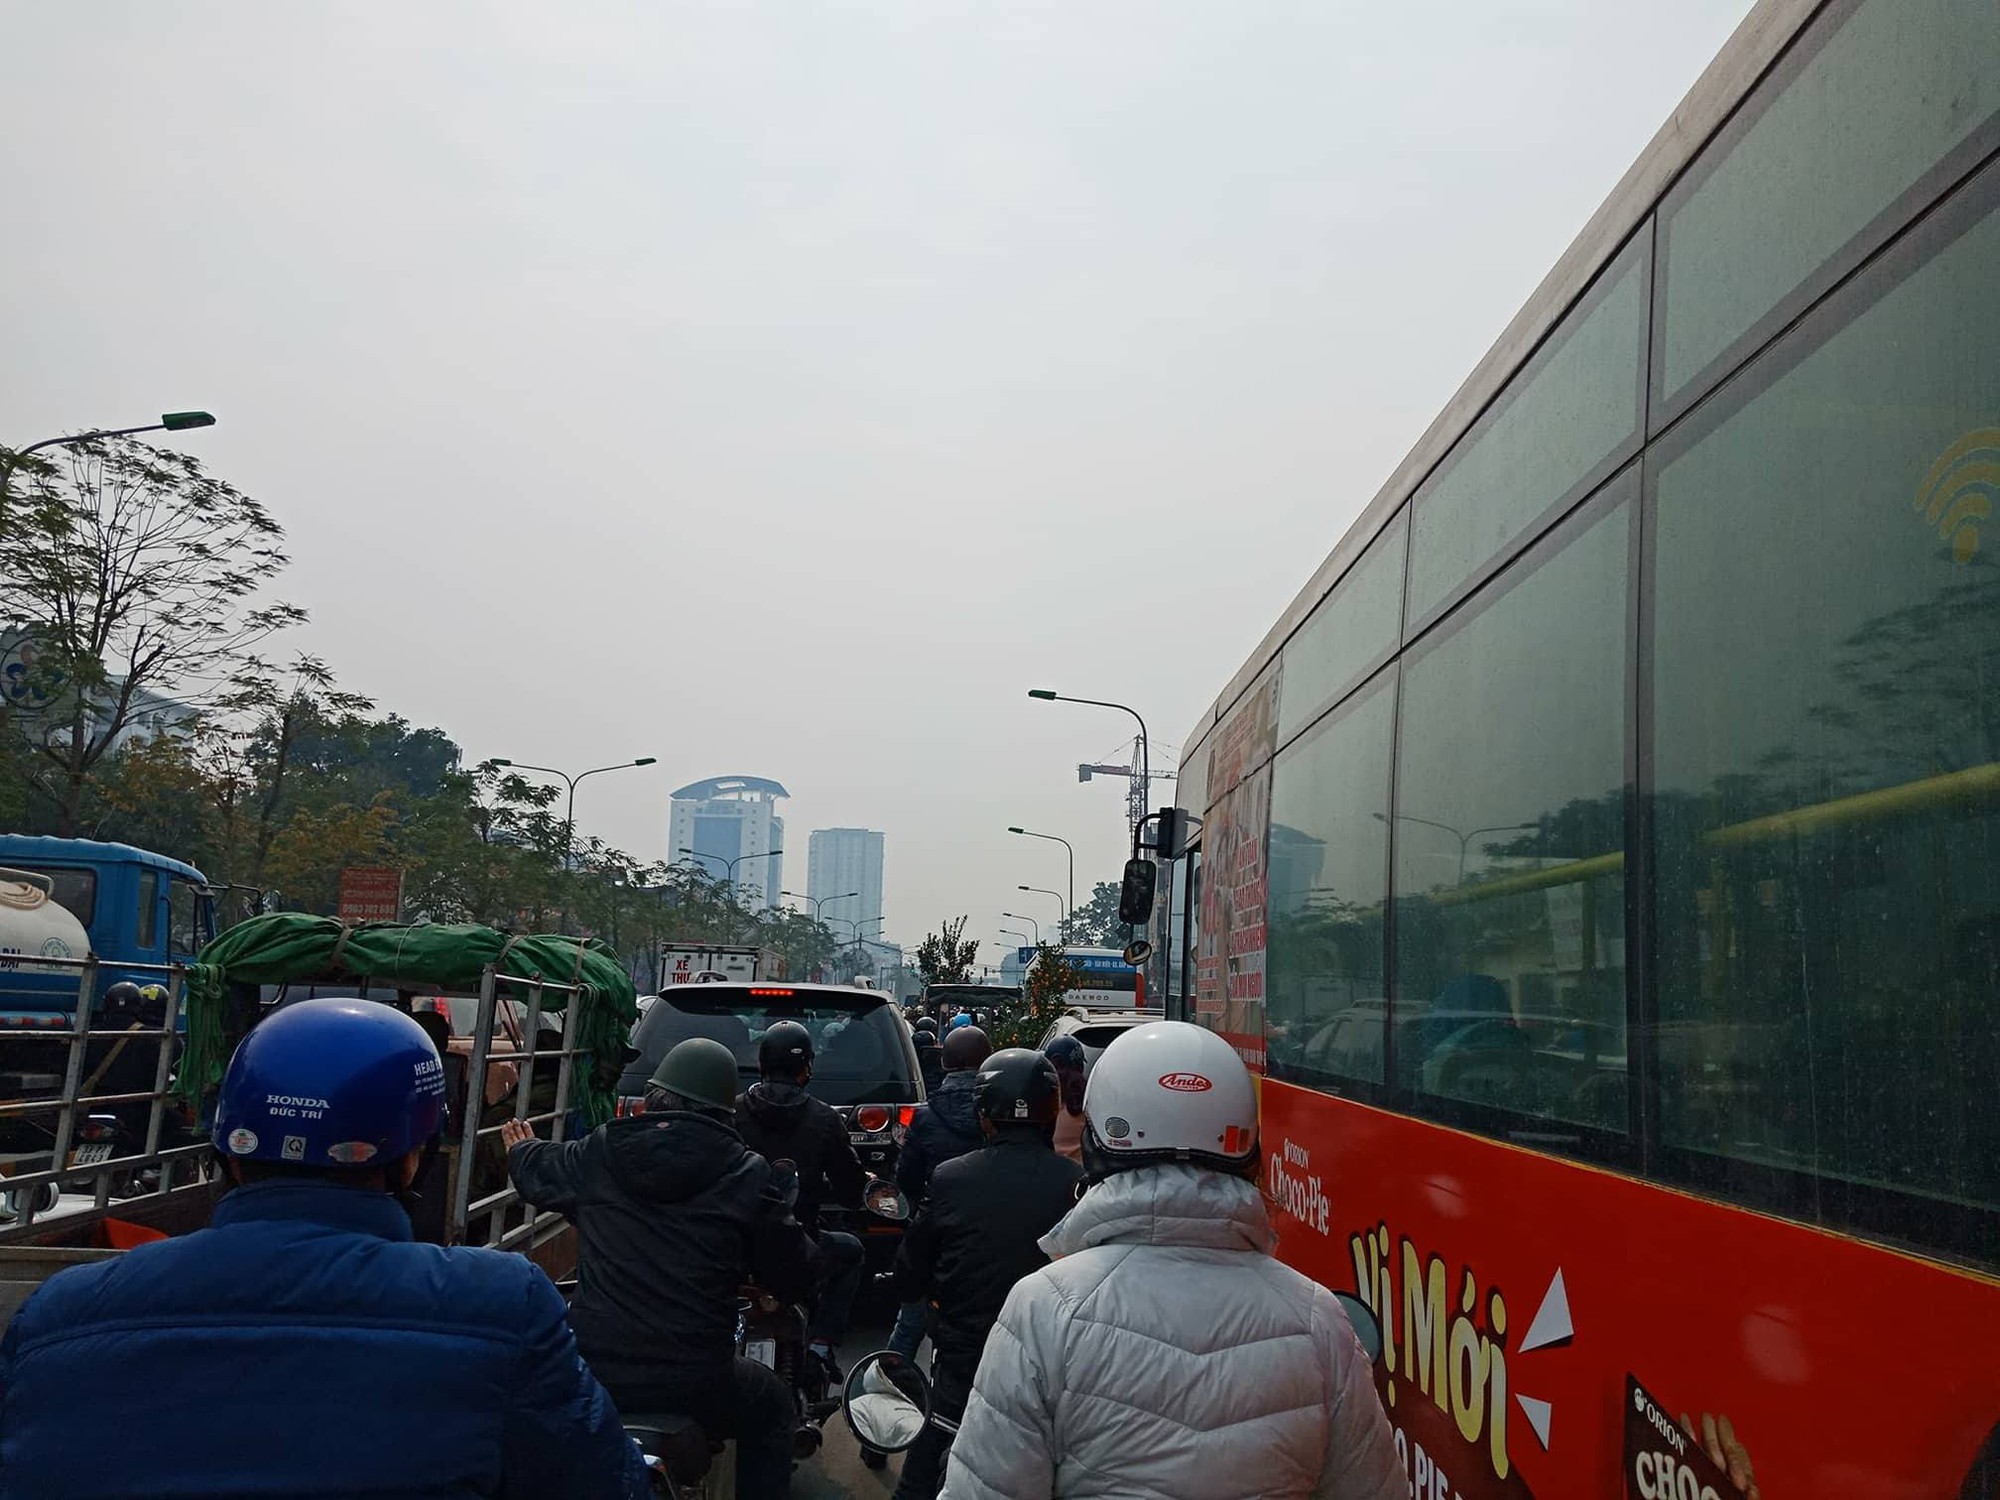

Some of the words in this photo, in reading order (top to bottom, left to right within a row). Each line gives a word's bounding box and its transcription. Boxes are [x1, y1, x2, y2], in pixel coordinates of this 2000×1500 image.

[676, 960, 688, 971] XE
[414, 1060, 436, 1077] HEAD
[266, 1094, 330, 1109] HONDA
[269, 1106, 297, 1117] ĐỨC
[301, 1109, 323, 1120] TRÍ
[1402, 1239, 1509, 1480] Mới
[1646, 1402, 1685, 1456] ORION
